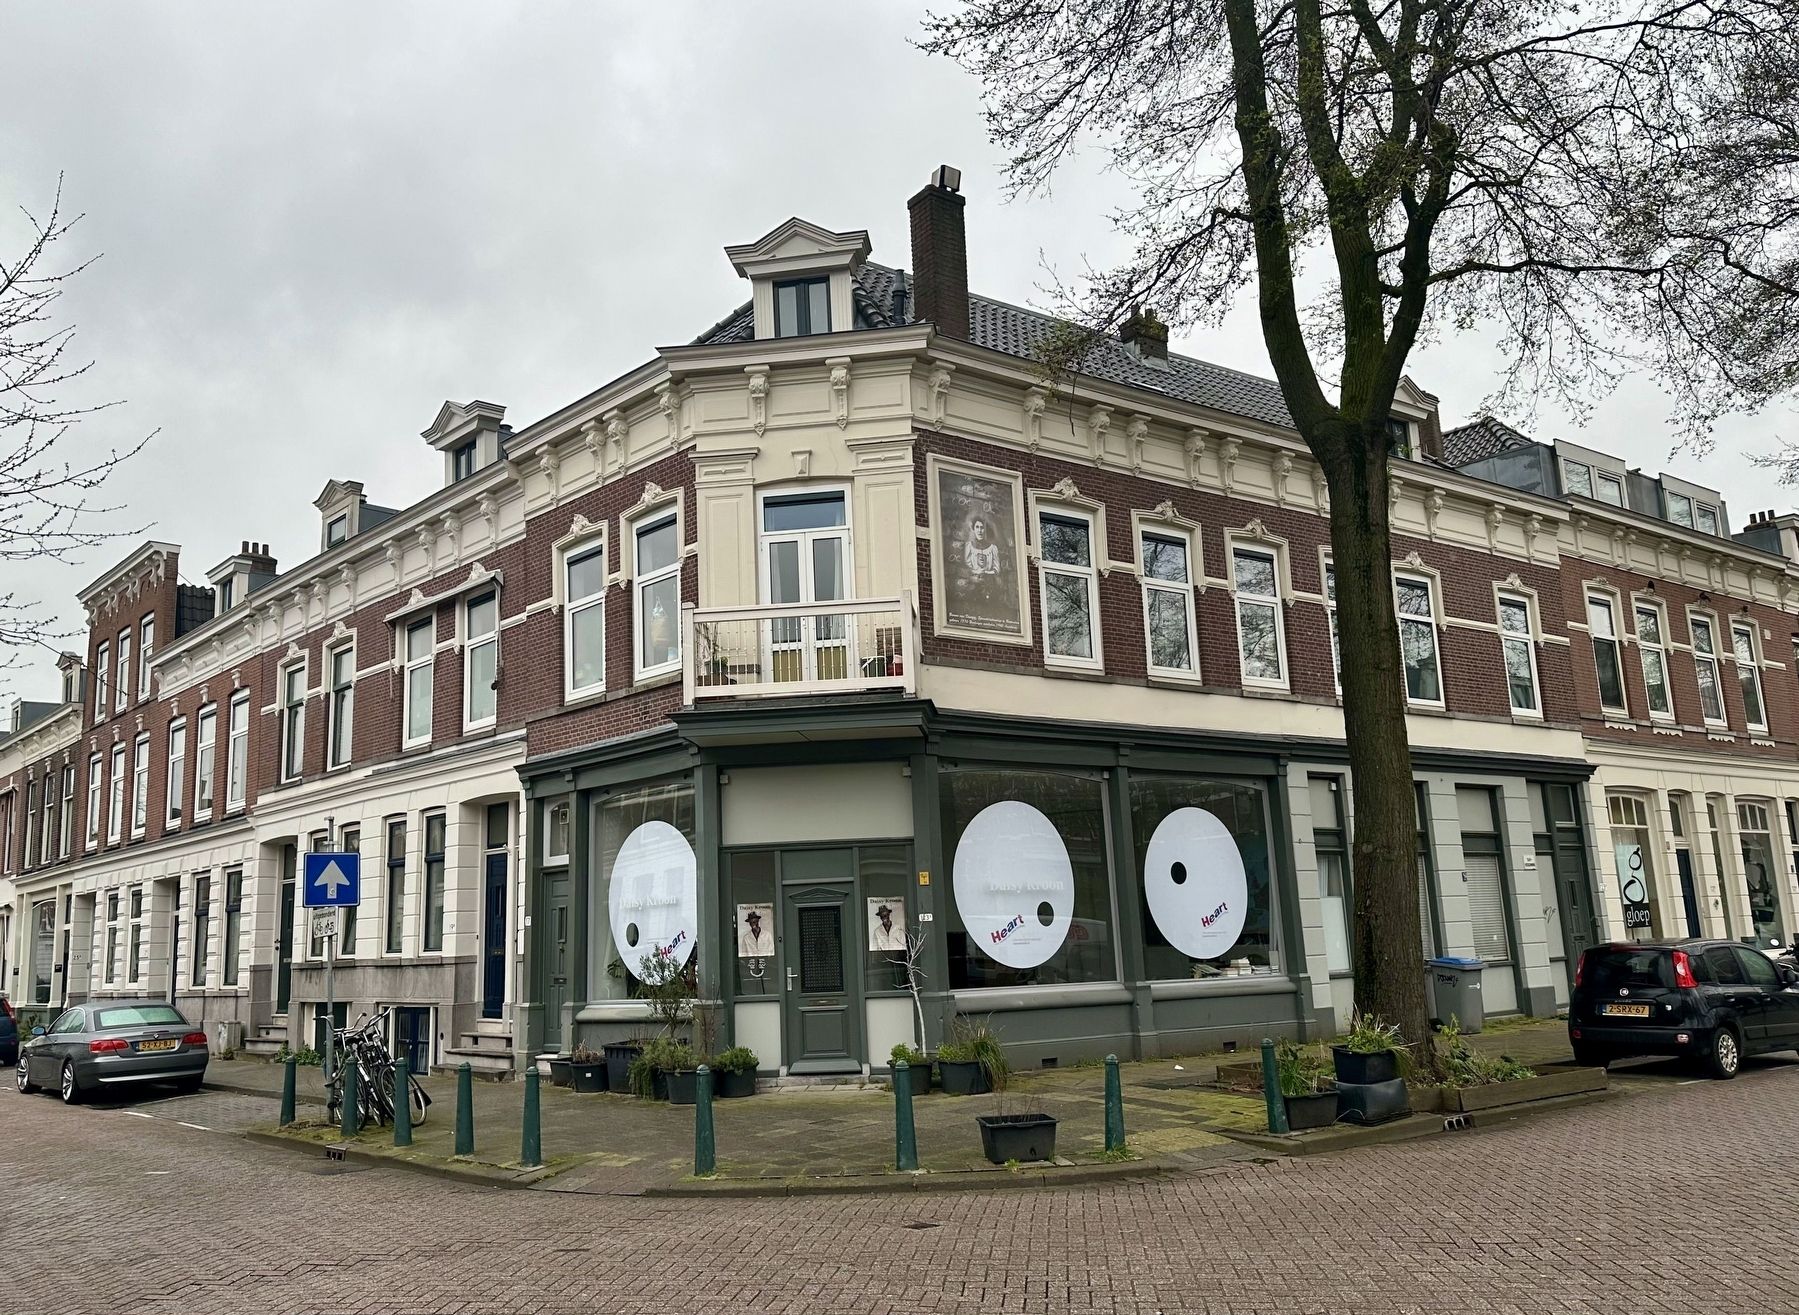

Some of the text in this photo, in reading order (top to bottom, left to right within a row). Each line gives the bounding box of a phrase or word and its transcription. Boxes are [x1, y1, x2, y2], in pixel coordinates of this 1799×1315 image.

[1027, 879, 1064, 891] Kroon
[1201, 902, 1228, 928] Heart
[1626, 906, 1650, 927] gloep
[991, 914, 1024, 943] Heart
[660, 930, 686, 959] Heart
[1609, 1005, 1646, 1014] 2-SRX-67
